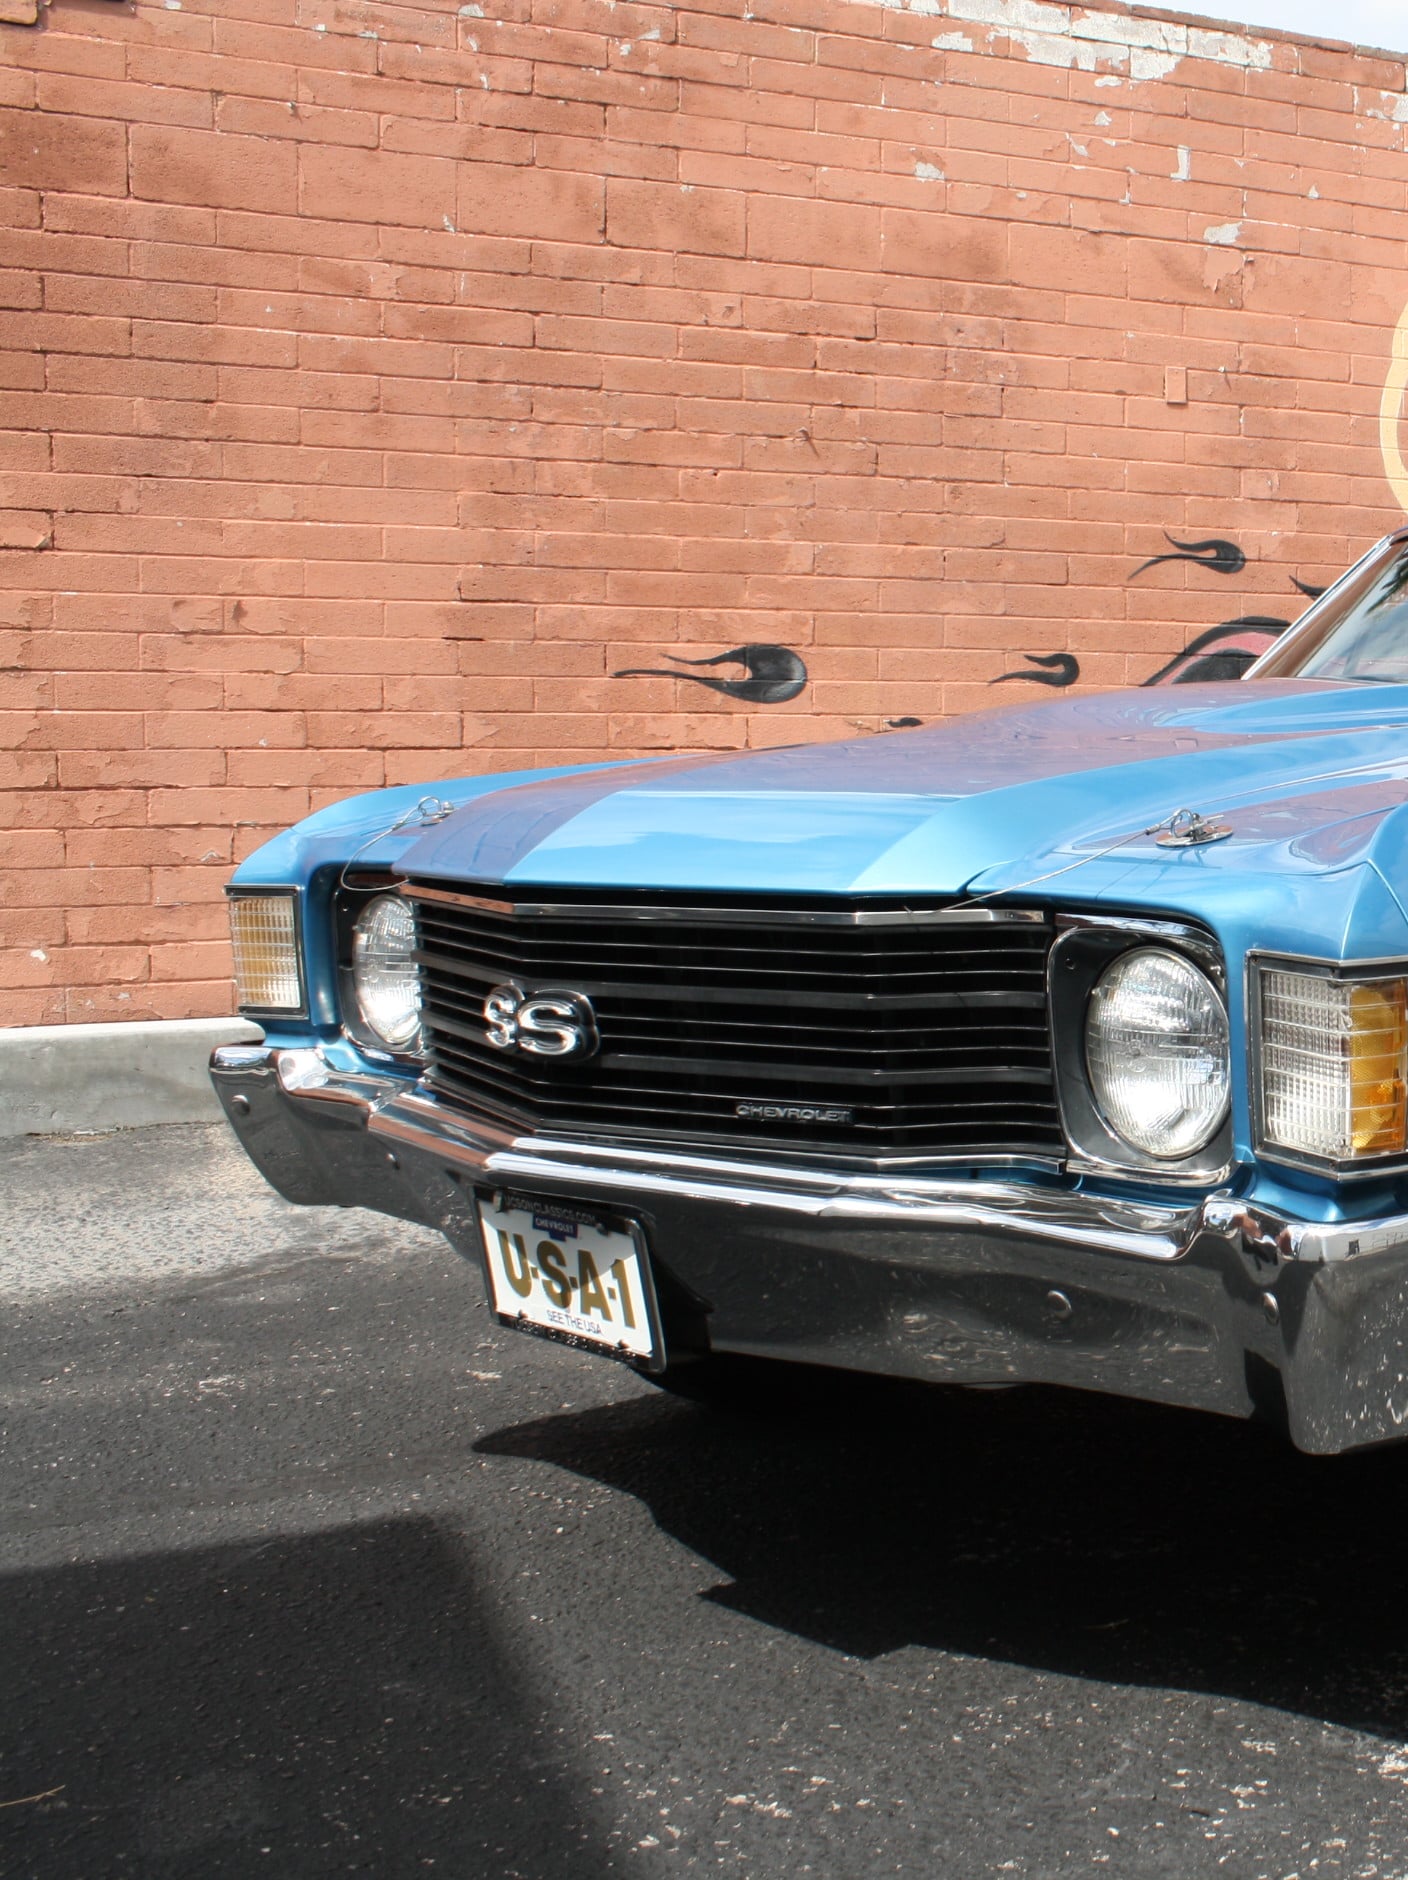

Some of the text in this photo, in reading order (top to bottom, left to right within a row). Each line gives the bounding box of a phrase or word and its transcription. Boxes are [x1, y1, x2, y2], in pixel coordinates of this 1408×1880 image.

[483, 985, 592, 1057] SS
[735, 1103, 852, 1123] CHEVROLET
[535, 1217, 575, 1234] CHEVROLET
[546, 1309, 603, 1335] SEE THE USA
